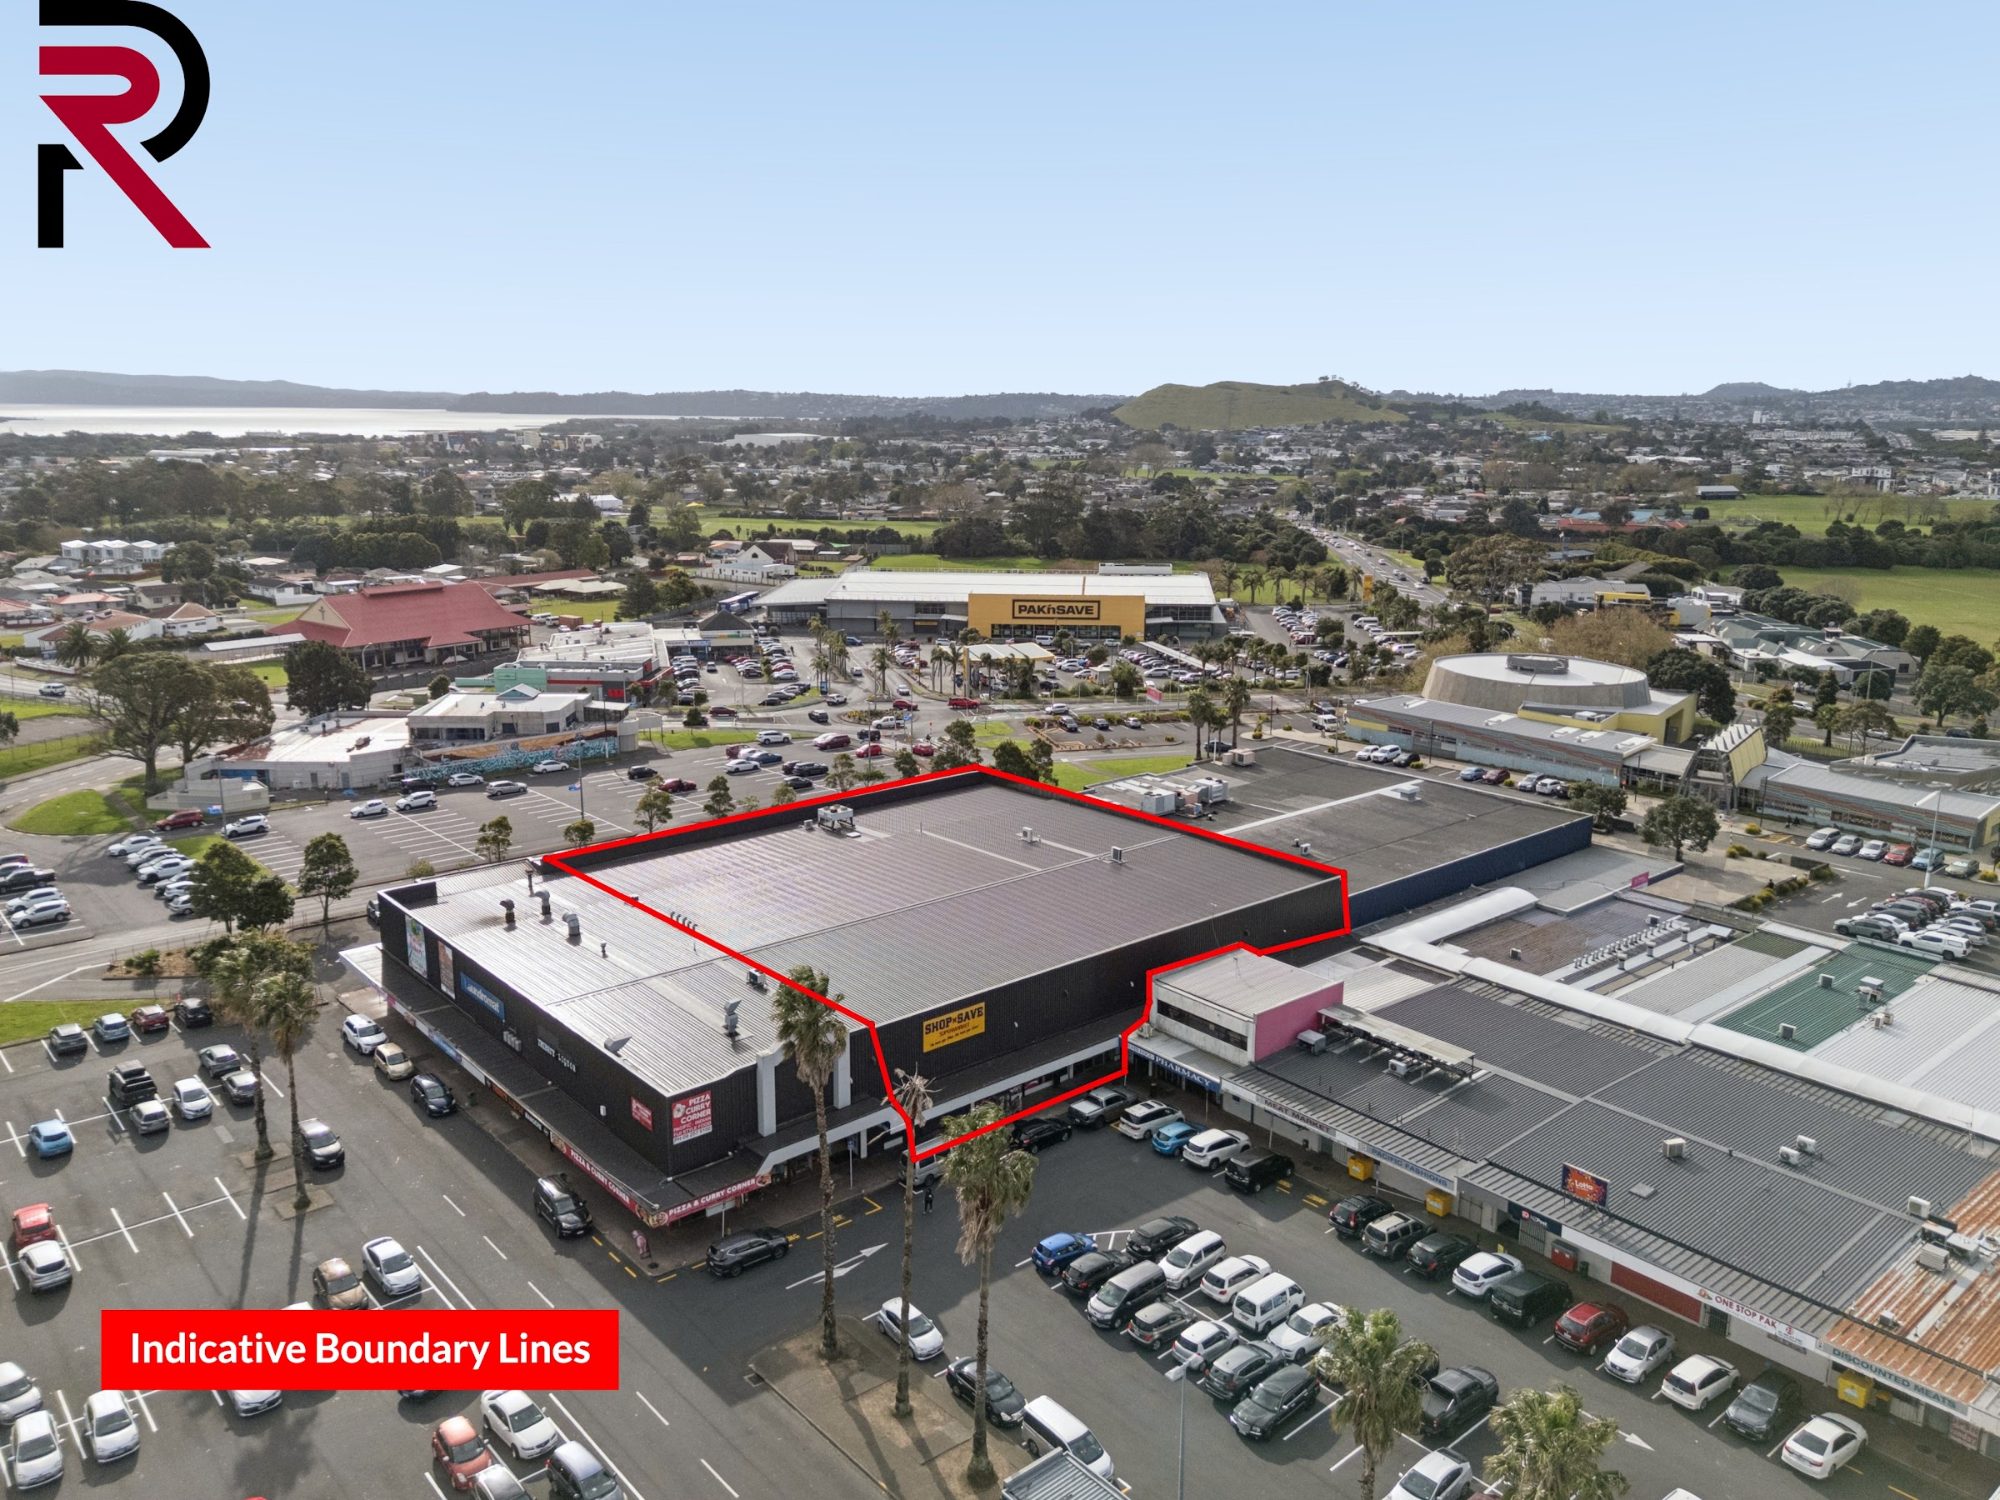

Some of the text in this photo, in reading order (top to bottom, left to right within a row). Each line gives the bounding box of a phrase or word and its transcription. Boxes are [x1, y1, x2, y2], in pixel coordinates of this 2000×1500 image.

[925, 1017, 952, 1035] SHOP
[957, 1006, 984, 1023] SAVE
[1155, 1056, 1211, 1086] PHARMACY
[680, 1108, 711, 1124] CORNER
[685, 1100, 711, 1115] CURRY
[688, 1094, 711, 1106] PIZZA
[1264, 1099, 1329, 1133] MEAT MARKET
[1371, 1147, 1448, 1188] PACIFIC FASHIONS
[668, 1203, 692, 1216] PIZZA
[700, 1189, 725, 1204] CURRY
[726, 1178, 756, 1195] CORNER
[1714, 1294, 1735, 1310] ONE
[1735, 1303, 1758, 1320] STOP
[1759, 1315, 1777, 1330] PAK
[1832, 1348, 1957, 1409] DISCOUNTED MEATS
